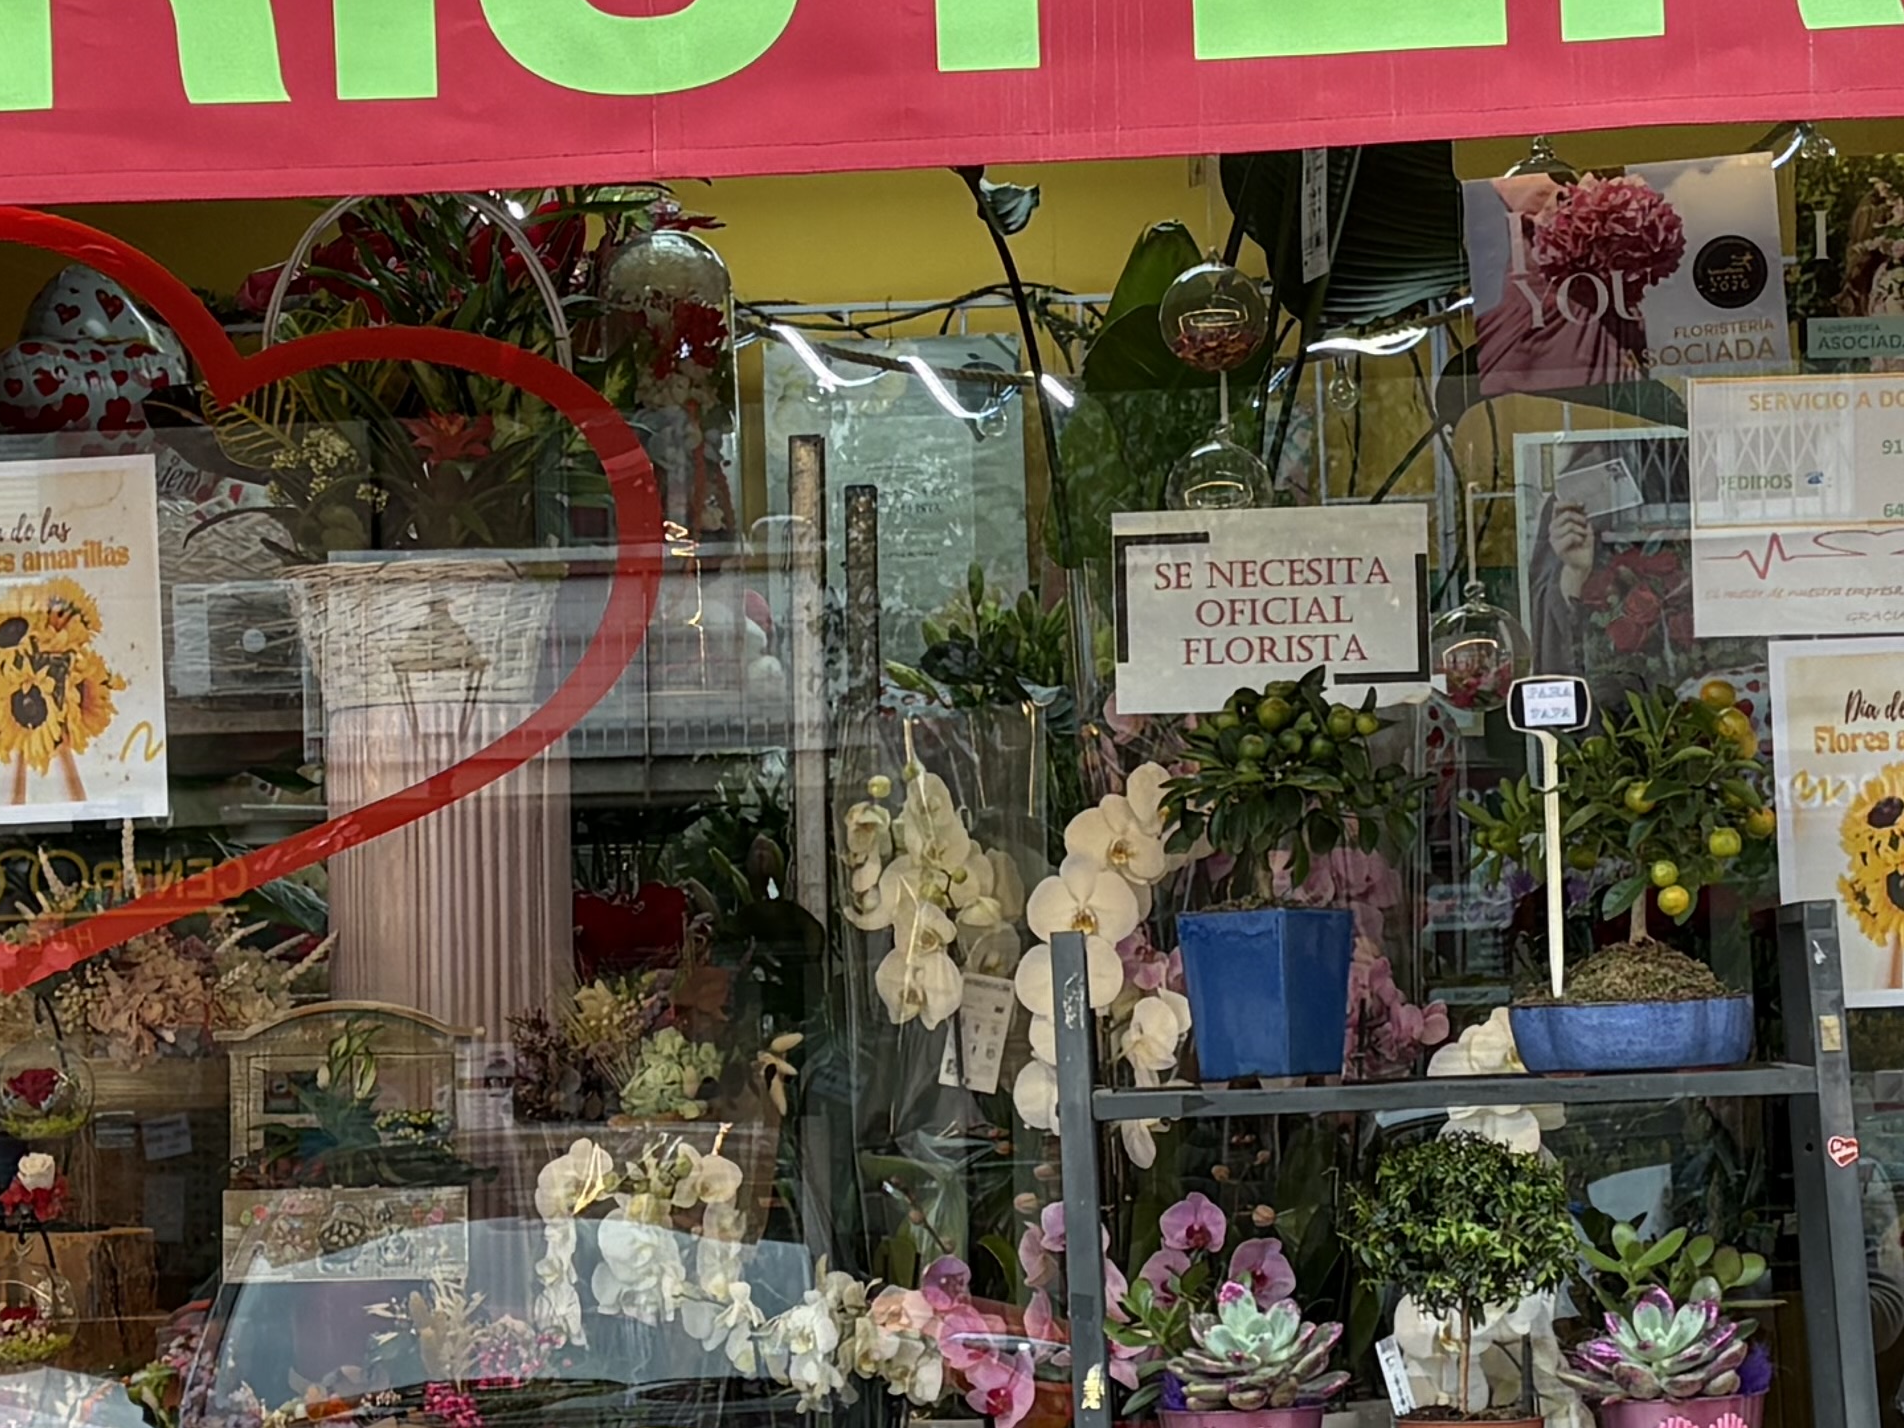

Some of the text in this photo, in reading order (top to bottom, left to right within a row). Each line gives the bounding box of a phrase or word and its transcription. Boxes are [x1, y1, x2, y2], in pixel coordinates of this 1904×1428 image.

[1508, 212, 1531, 276] I
[1813, 210, 1831, 260] I
[1514, 269, 1642, 330] YOU
[1622, 337, 1777, 369] ASOCIADA
[1748, 388, 1850, 413] SERVICIO
[1855, 390, 1874, 408] A
[1716, 471, 1793, 491] PEDIDOS
[39, 506, 72, 546] las
[21, 539, 130, 572] amarillas
[1154, 555, 1392, 592] SE NECESITA
[1194, 595, 1354, 628] OFICIAL
[1181, 632, 1369, 667] FLORISTA
[1813, 723, 1892, 755] Flores
